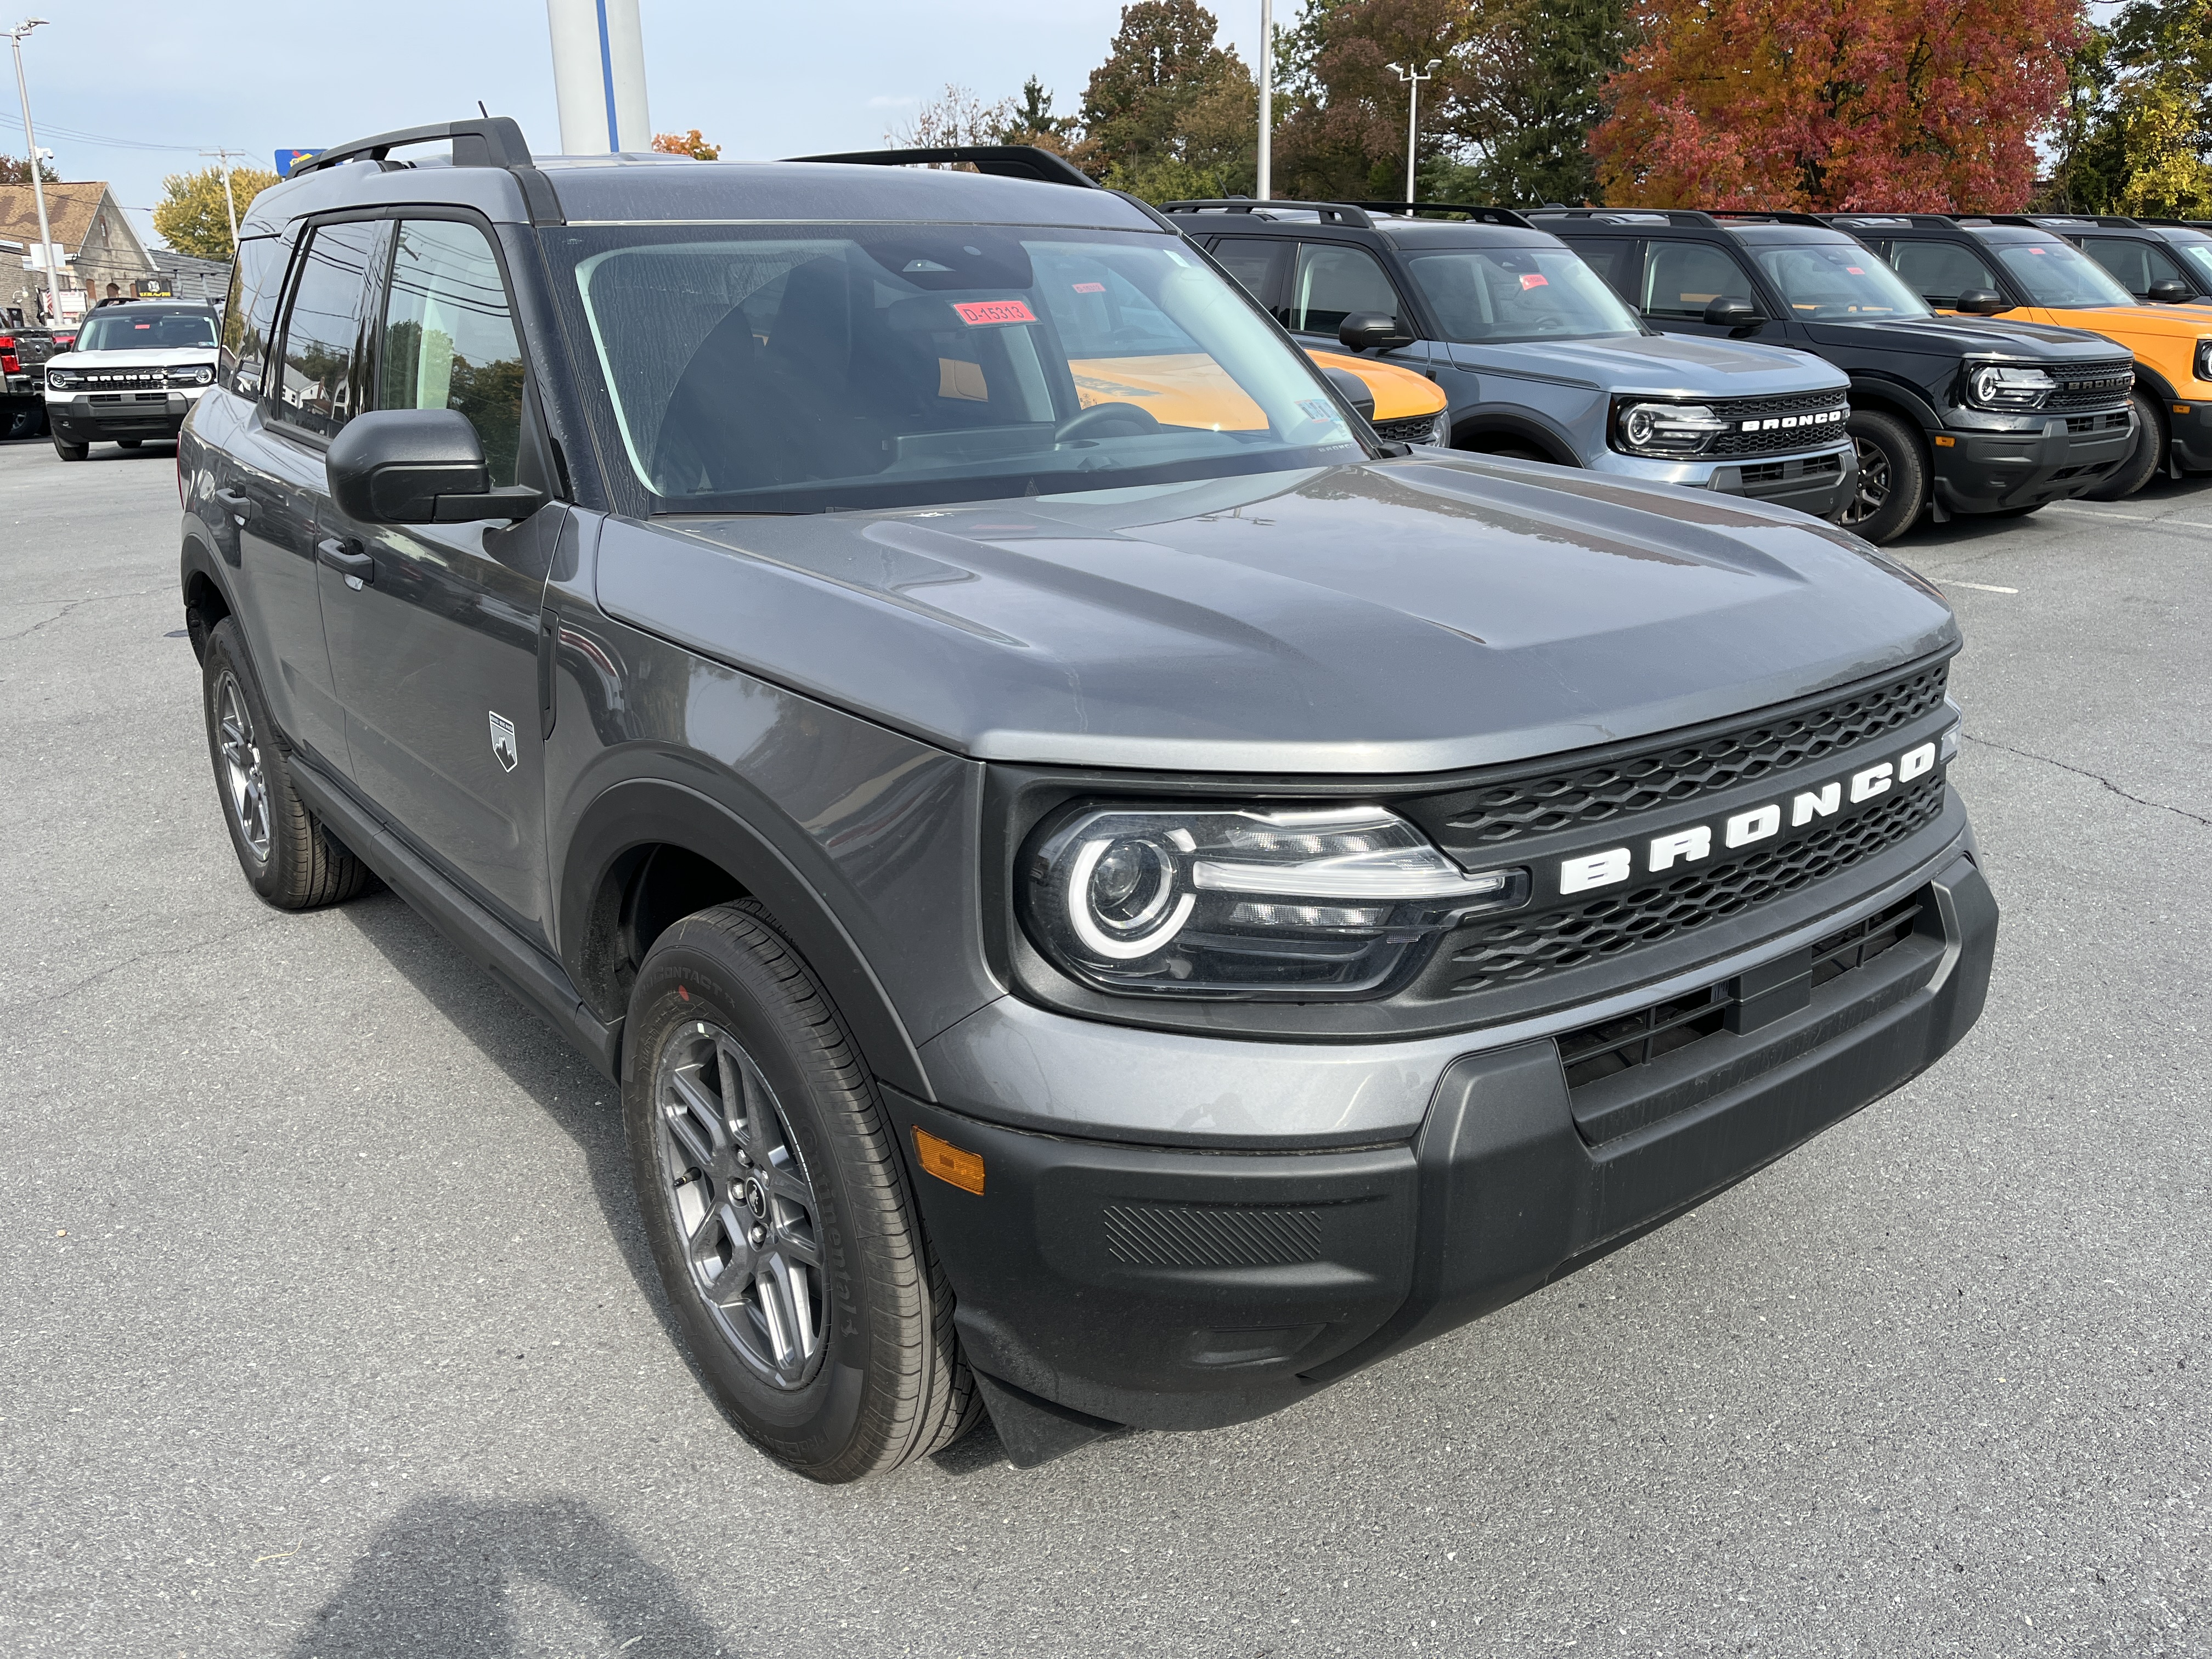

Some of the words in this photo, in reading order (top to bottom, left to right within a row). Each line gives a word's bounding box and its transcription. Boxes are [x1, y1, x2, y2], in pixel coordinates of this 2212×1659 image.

[963, 306, 1024, 321] D-15313
[2068, 377, 2131, 390] BRONCO
[1742, 411, 1841, 432] BRONCO
[1318, 443, 1356, 453] BRONCO
[490, 715, 499, 724] BIG
[499, 720, 514, 732] BEND
[1560, 742, 1936, 895] BRONCO
